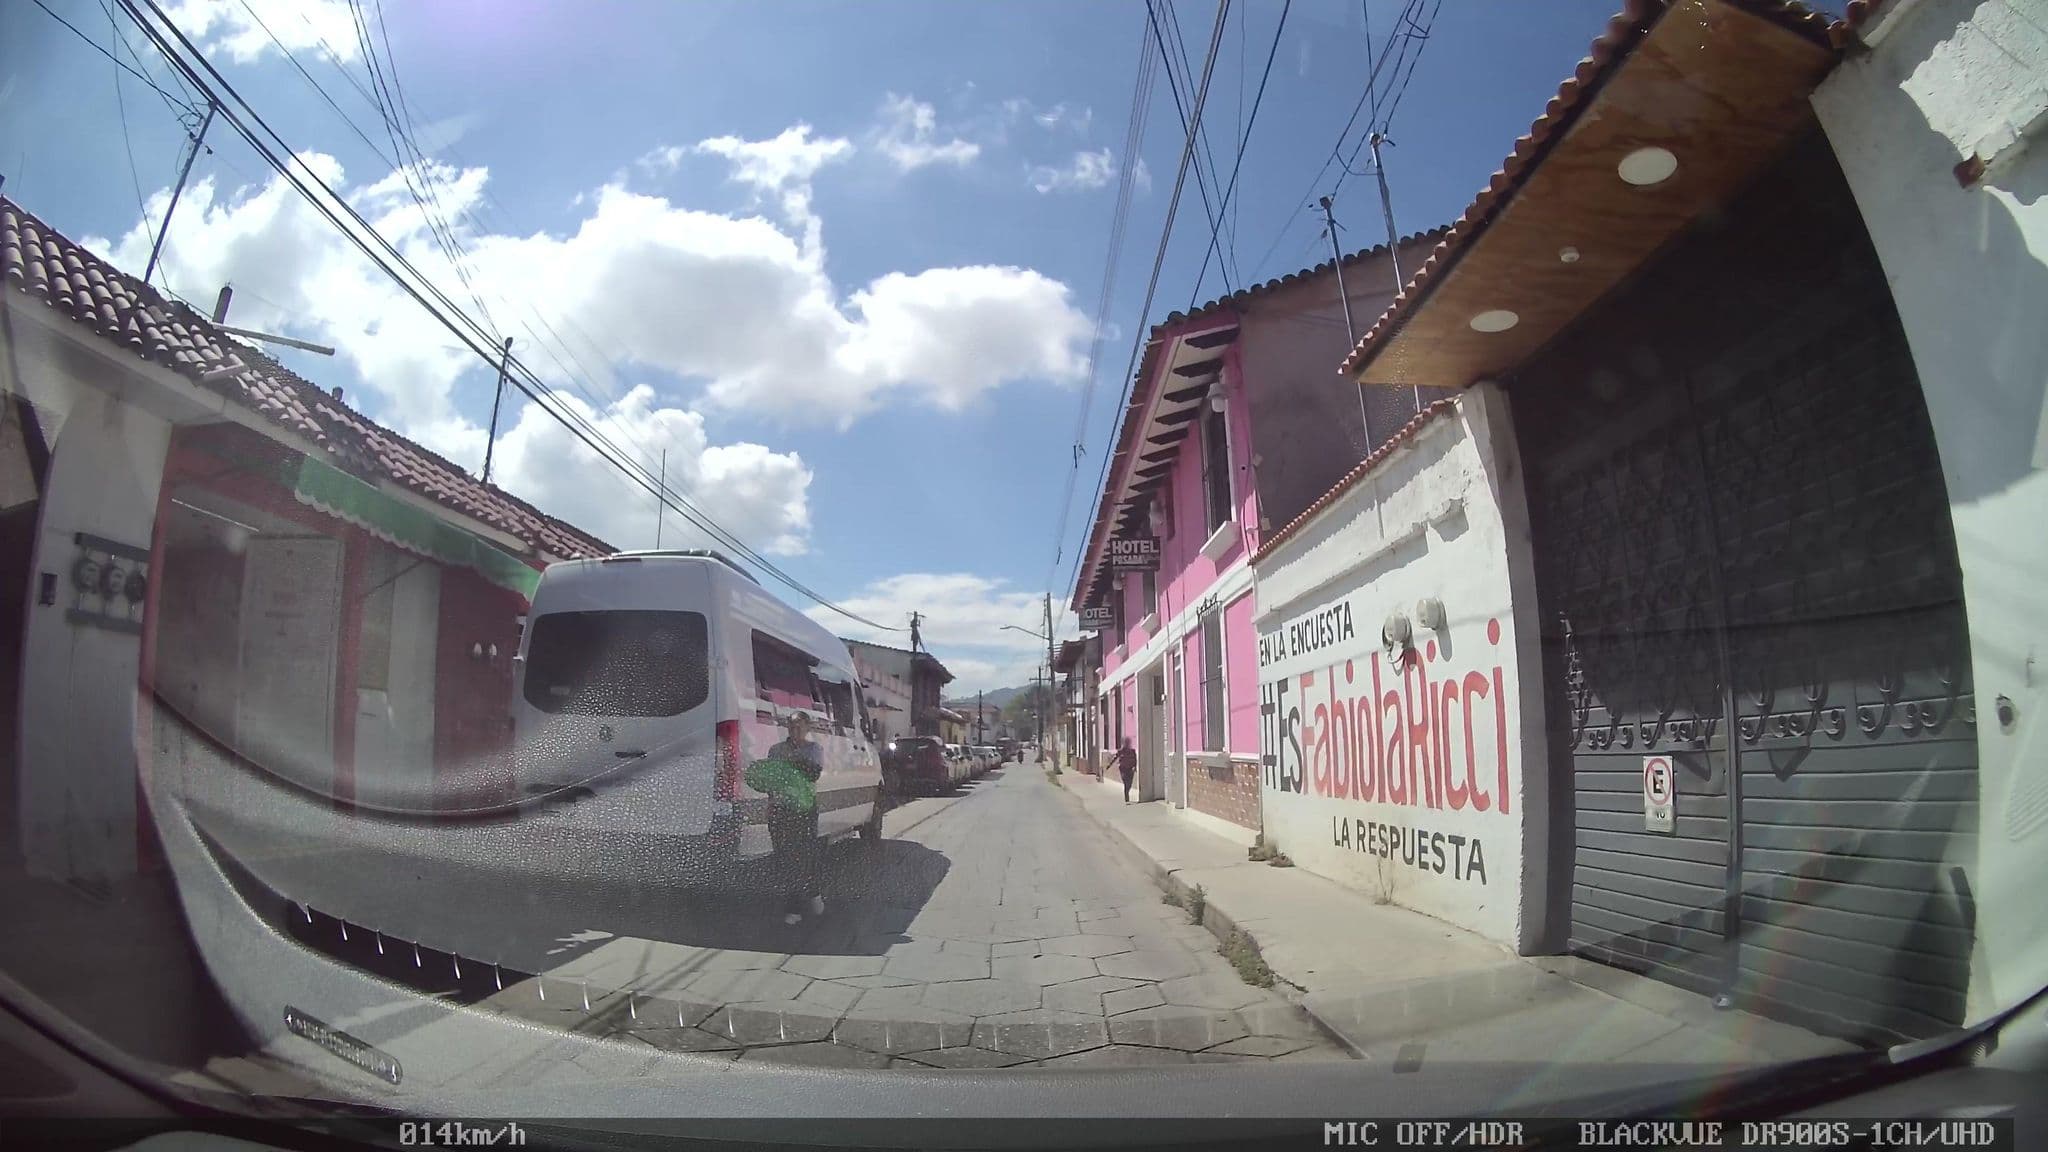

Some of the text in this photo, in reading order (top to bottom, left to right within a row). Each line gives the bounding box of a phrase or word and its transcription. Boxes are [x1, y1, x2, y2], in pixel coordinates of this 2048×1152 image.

[1112, 540, 1159, 554] HOTEL
[1260, 600, 1354, 666] EN LA ENCUESTA
[1260, 617, 1510, 815] #EsFabiolaRicci
[1652, 769, 1664, 794] E
[1333, 816, 1487, 885] LA RESPUESTA
